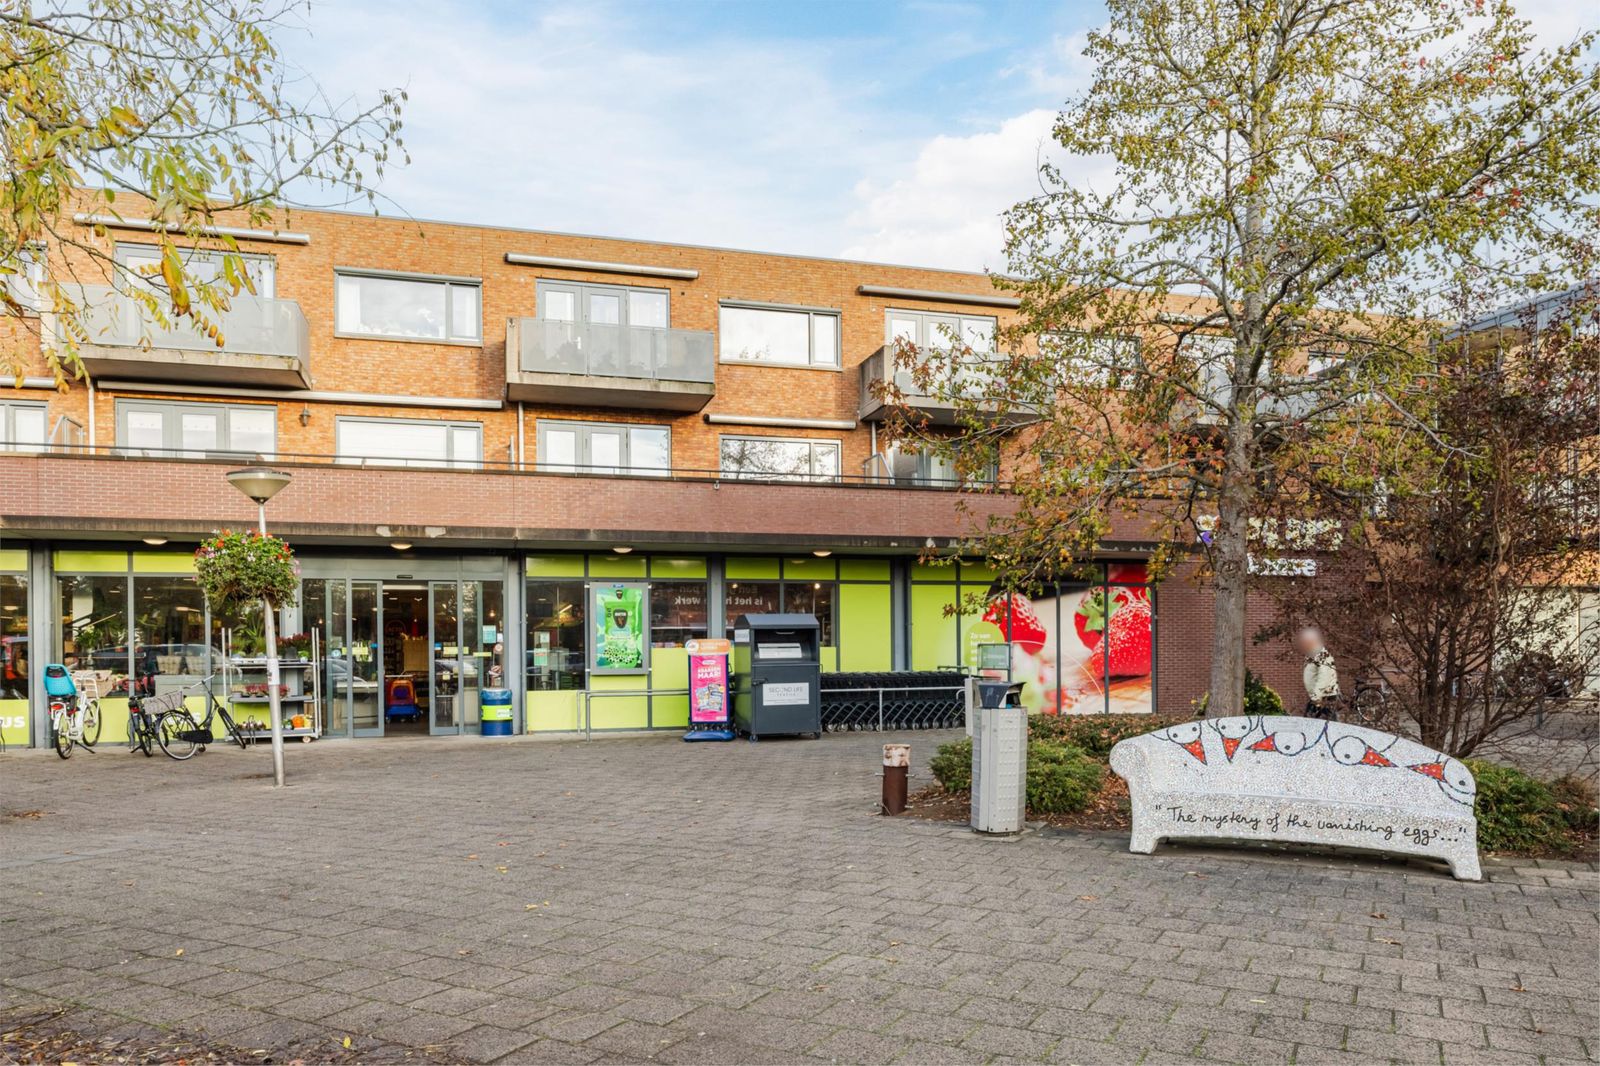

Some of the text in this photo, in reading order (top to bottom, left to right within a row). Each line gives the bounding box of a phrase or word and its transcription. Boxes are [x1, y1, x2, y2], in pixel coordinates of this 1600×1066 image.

[1201, 811, 1260, 830] mystery
[1266, 812, 1280, 833] of
[1286, 813, 1312, 828] the
[1317, 817, 1395, 841] vanishing
